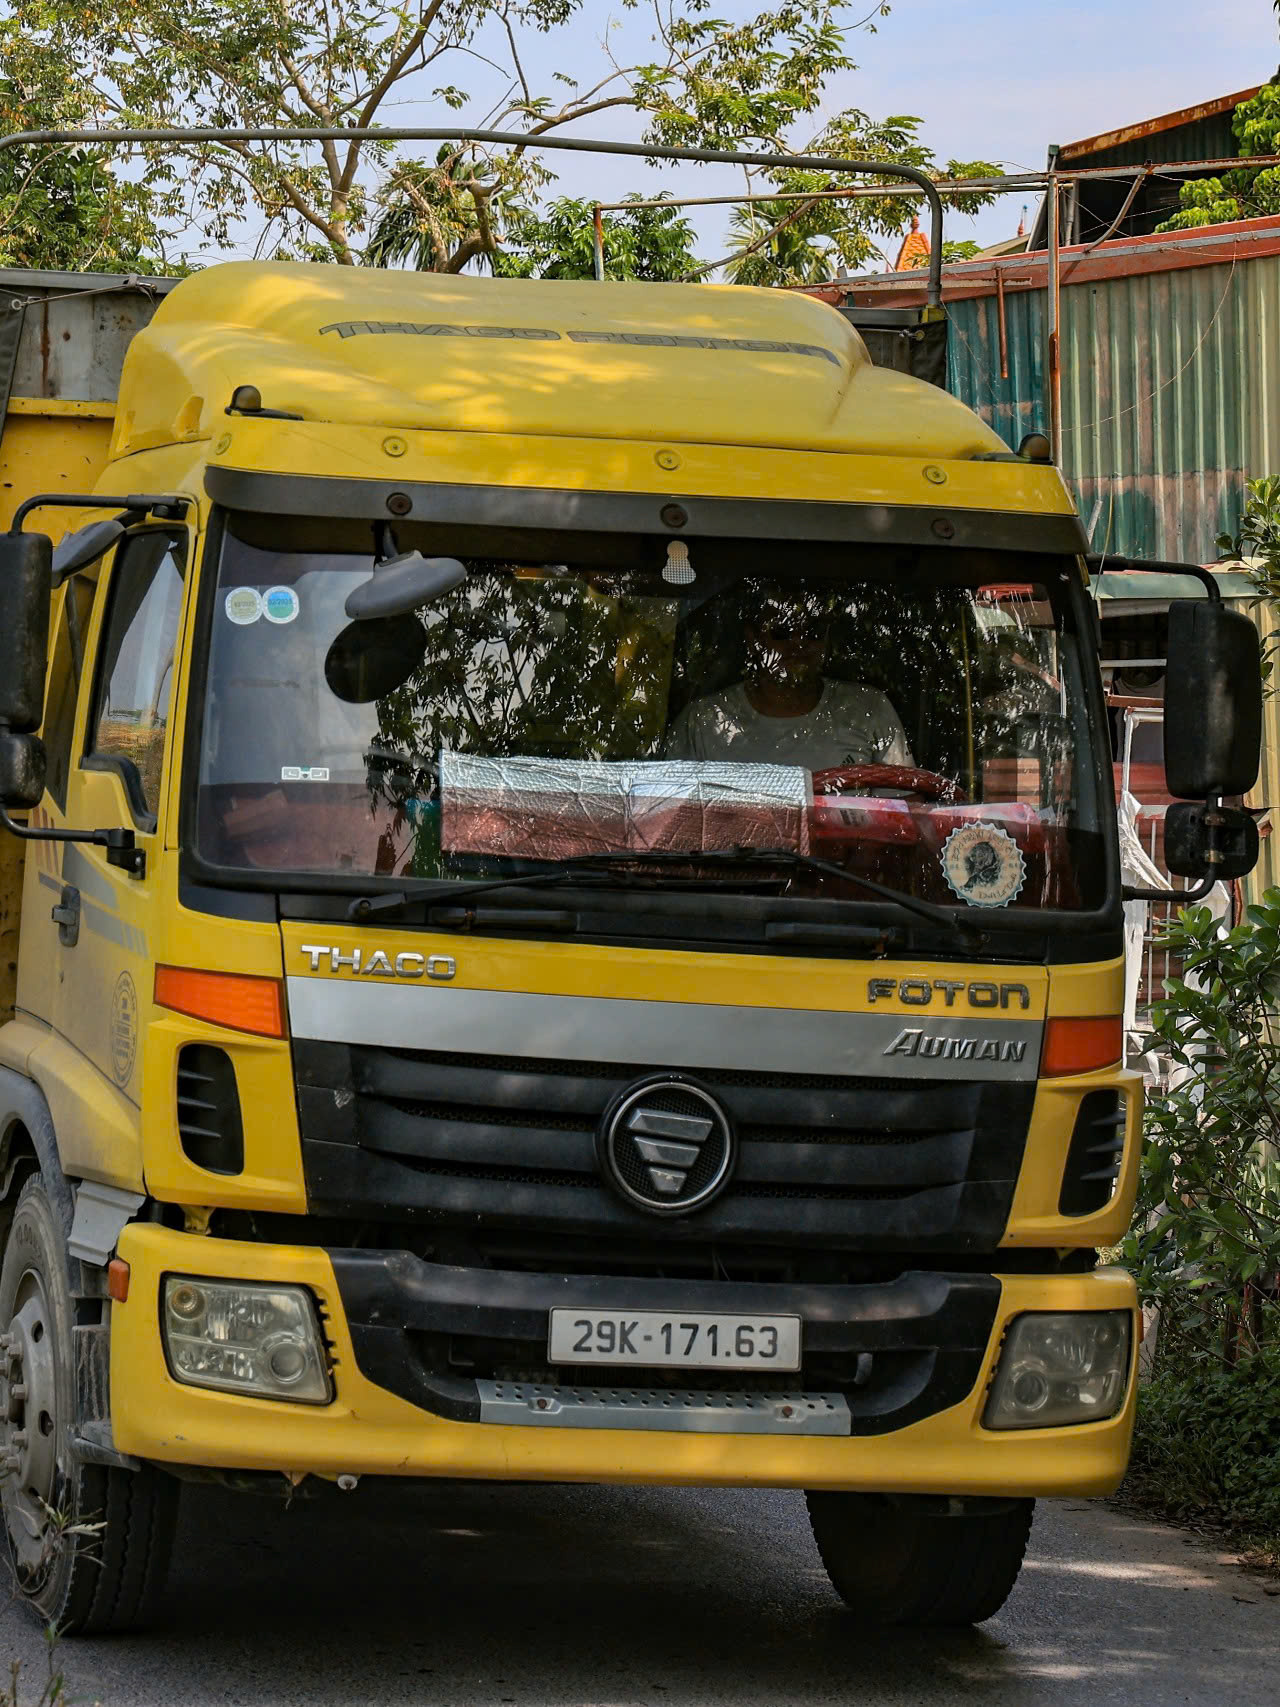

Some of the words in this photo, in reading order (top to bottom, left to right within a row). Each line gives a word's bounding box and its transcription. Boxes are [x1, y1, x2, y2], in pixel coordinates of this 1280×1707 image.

[319, 320, 561, 339] THACO
[566, 330, 842, 368] FOTON
[301, 944, 456, 980] THACO
[867, 977, 1030, 1010] FOTON
[572, 1319, 779, 1359] 29K-171.63
